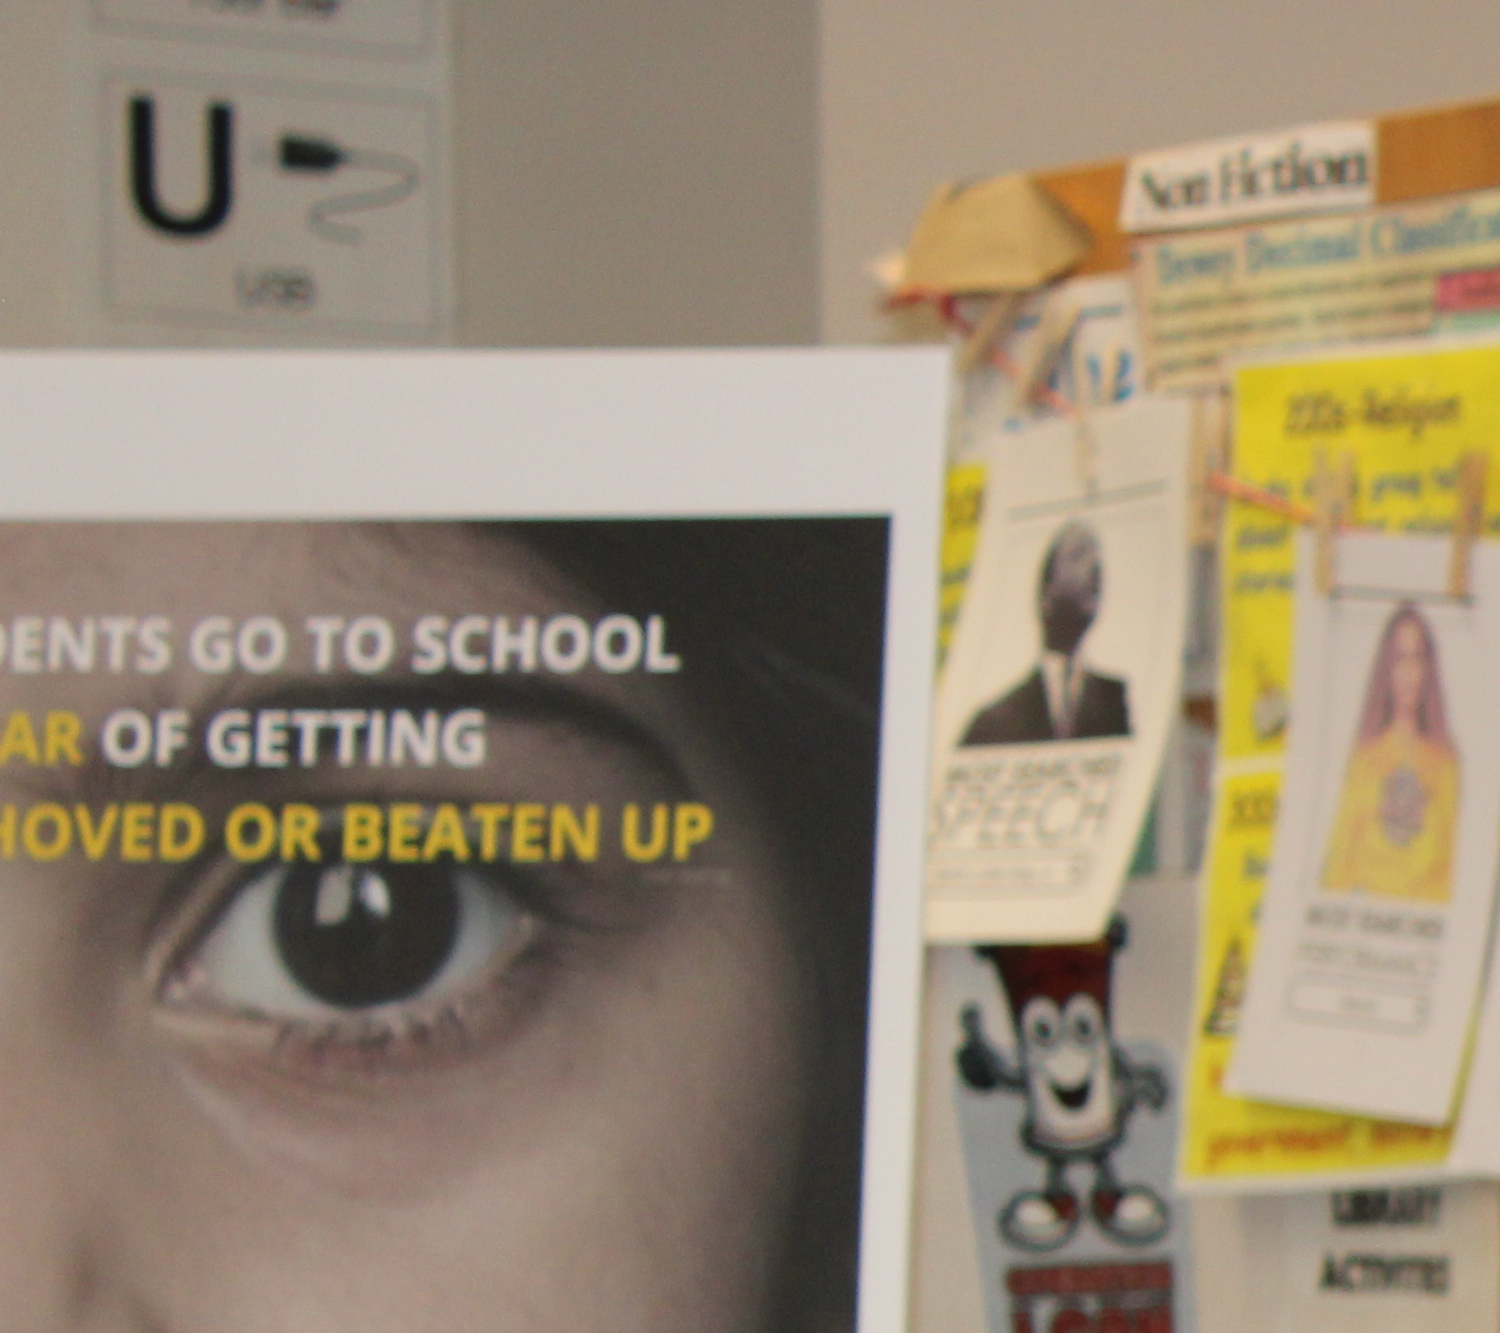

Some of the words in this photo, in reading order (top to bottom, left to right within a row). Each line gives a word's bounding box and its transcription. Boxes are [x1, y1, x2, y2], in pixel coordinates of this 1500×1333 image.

[125, 92, 236, 239] U
[1218, 141, 1370, 202] Fiction
[0, 615, 172, 674] ENTS
[188, 615, 287, 674] GO
[306, 615, 395, 674] TO
[411, 615, 681, 674] SCHOOL
[0, 711, 83, 767] AR
[100, 710, 189, 767] OF
[206, 709, 487, 768] GETTING
[224, 803, 322, 861] OR
[342, 803, 598, 861] BEATEN
[622, 803, 714, 861] UP
